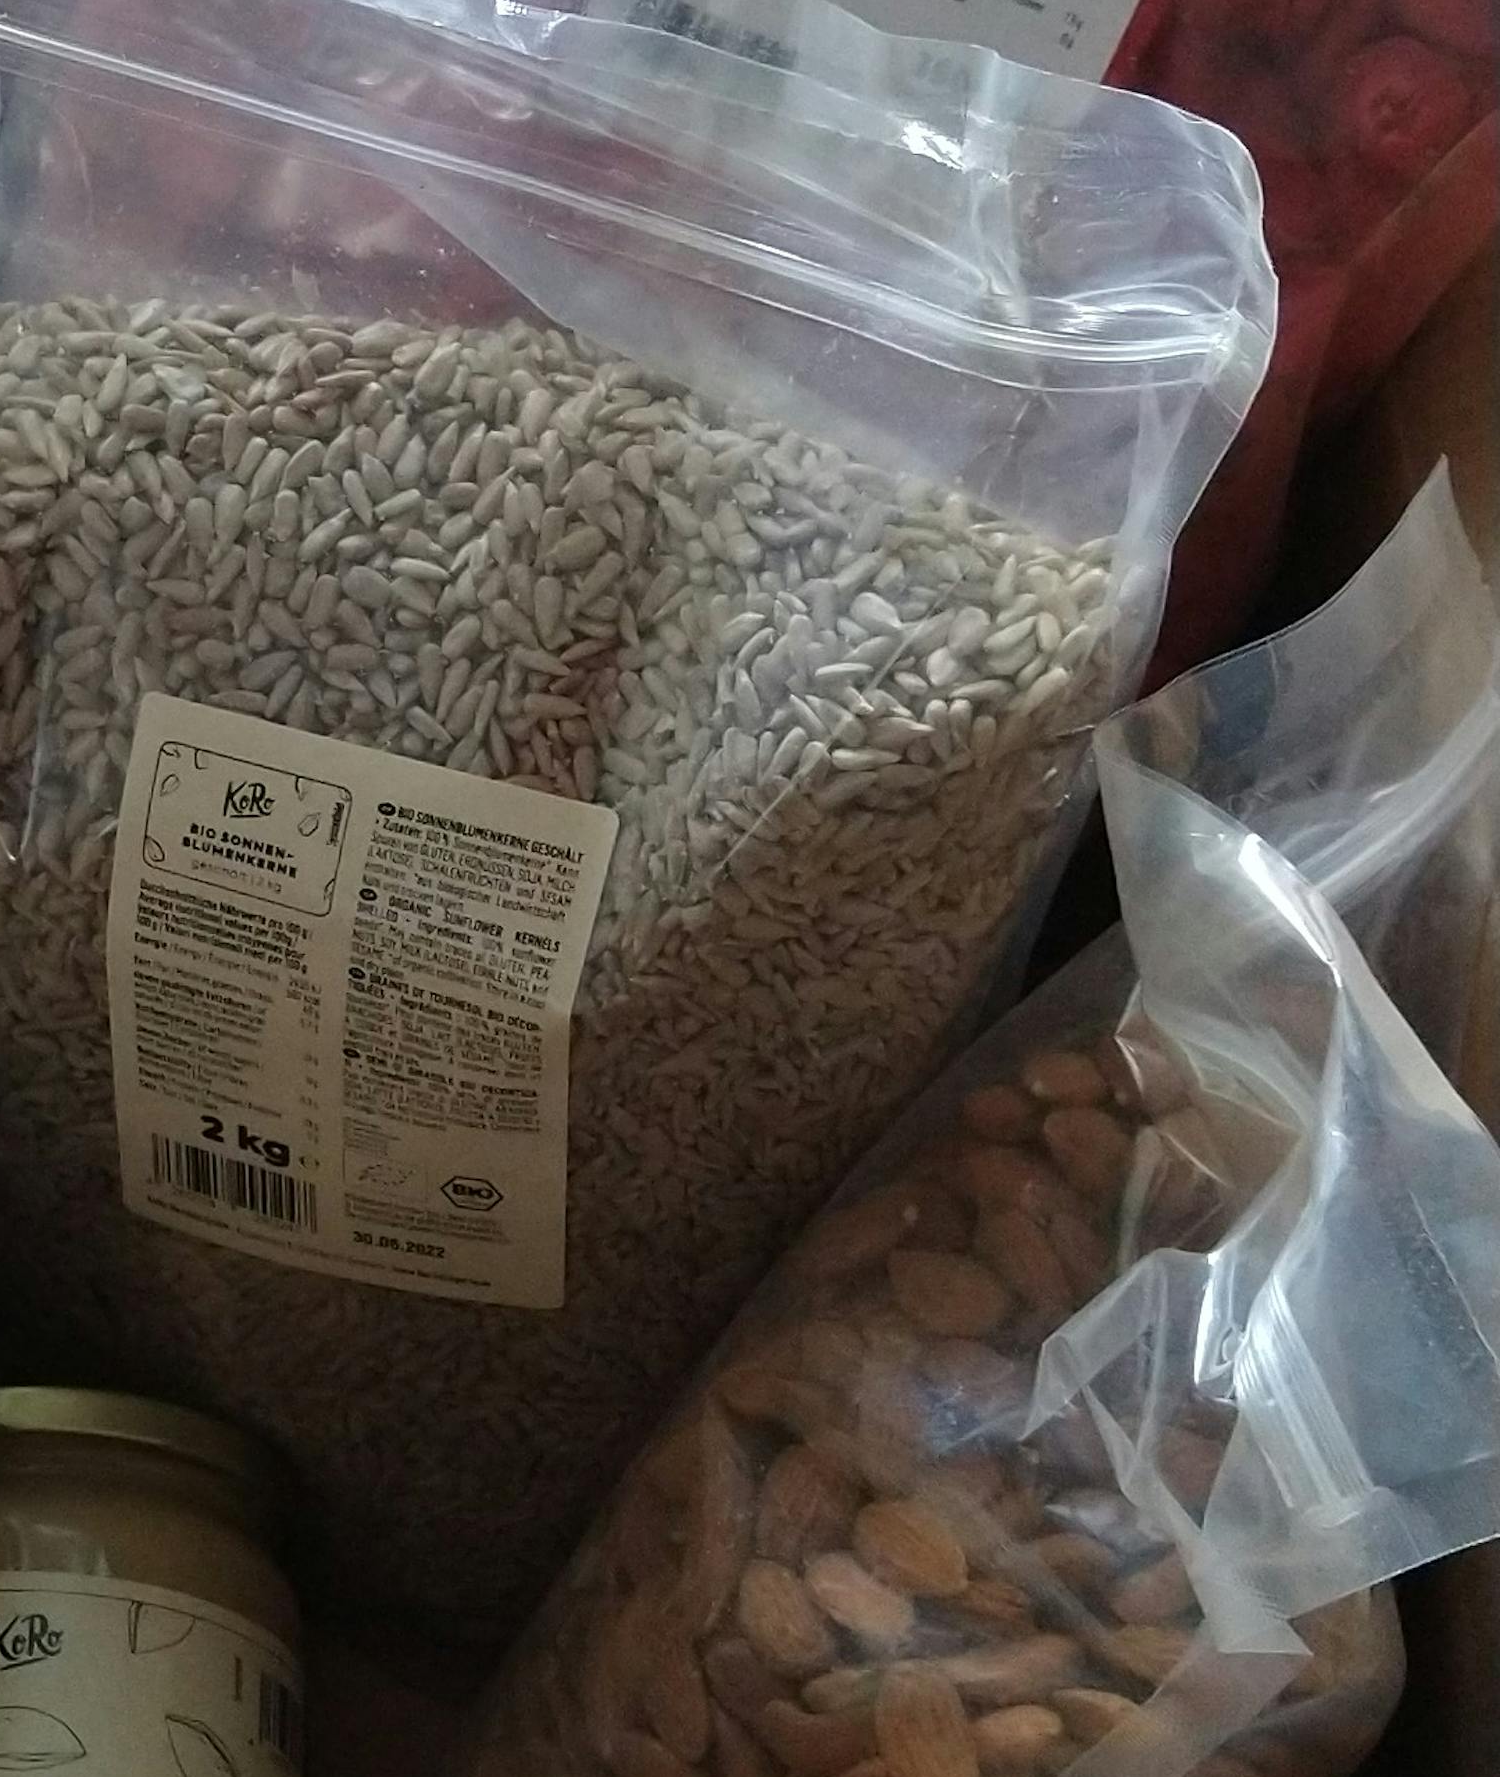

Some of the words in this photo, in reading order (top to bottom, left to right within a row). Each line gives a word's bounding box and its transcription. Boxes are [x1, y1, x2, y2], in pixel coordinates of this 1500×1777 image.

[223, 780, 275, 818] KoRo
[182, 836, 297, 878] BLUMENKERNE
[190, 823, 217, 839] BIO
[220, 831, 295, 859] SONNEN-
[200, 1115, 225, 1143] 2
[238, 1125, 290, 1167] kg
